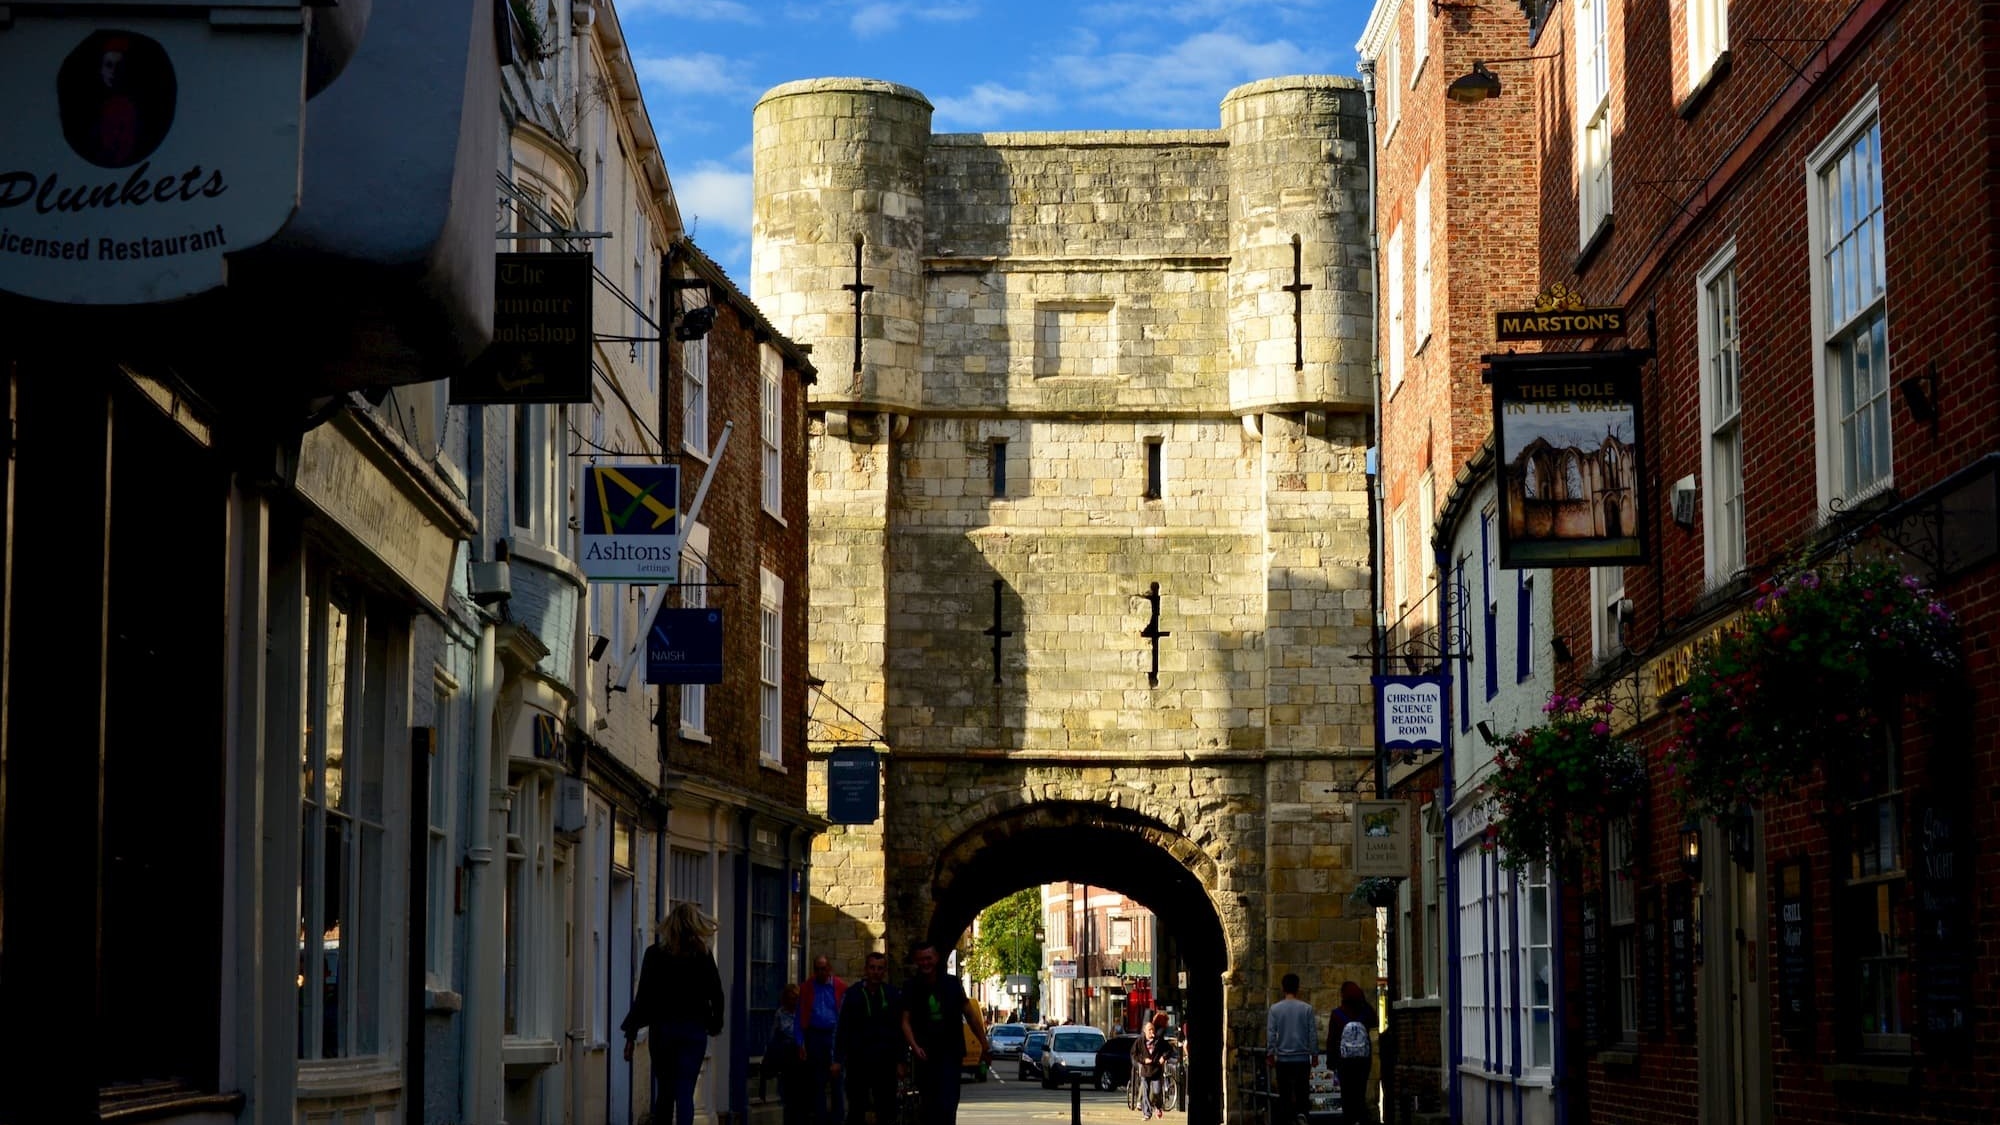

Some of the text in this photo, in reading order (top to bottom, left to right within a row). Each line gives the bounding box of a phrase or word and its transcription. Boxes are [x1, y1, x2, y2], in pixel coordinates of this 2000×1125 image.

[0, 162, 228, 214] Plunkets
[0, 224, 226, 260] icensed Restaurant
[500, 262, 545, 288] The
[495, 295, 577, 317] rimoire
[1502, 313, 1620, 333] MARSTON'S
[493, 322, 577, 345] ookshop
[1518, 382, 1615, 399] THE HOLE
[1506, 399, 1629, 415] IN THE WALL
[586, 541, 671, 561] Ashtons
[637, 563, 671, 573] Lettings
[651, 650, 685, 662] NAISH
[1387, 694, 1438, 703] CHRISTIAN
[1392, 705, 1433, 713] SCIENCE
[1391, 715, 1434, 724] READING
[1398, 726, 1427, 735] ROOM
